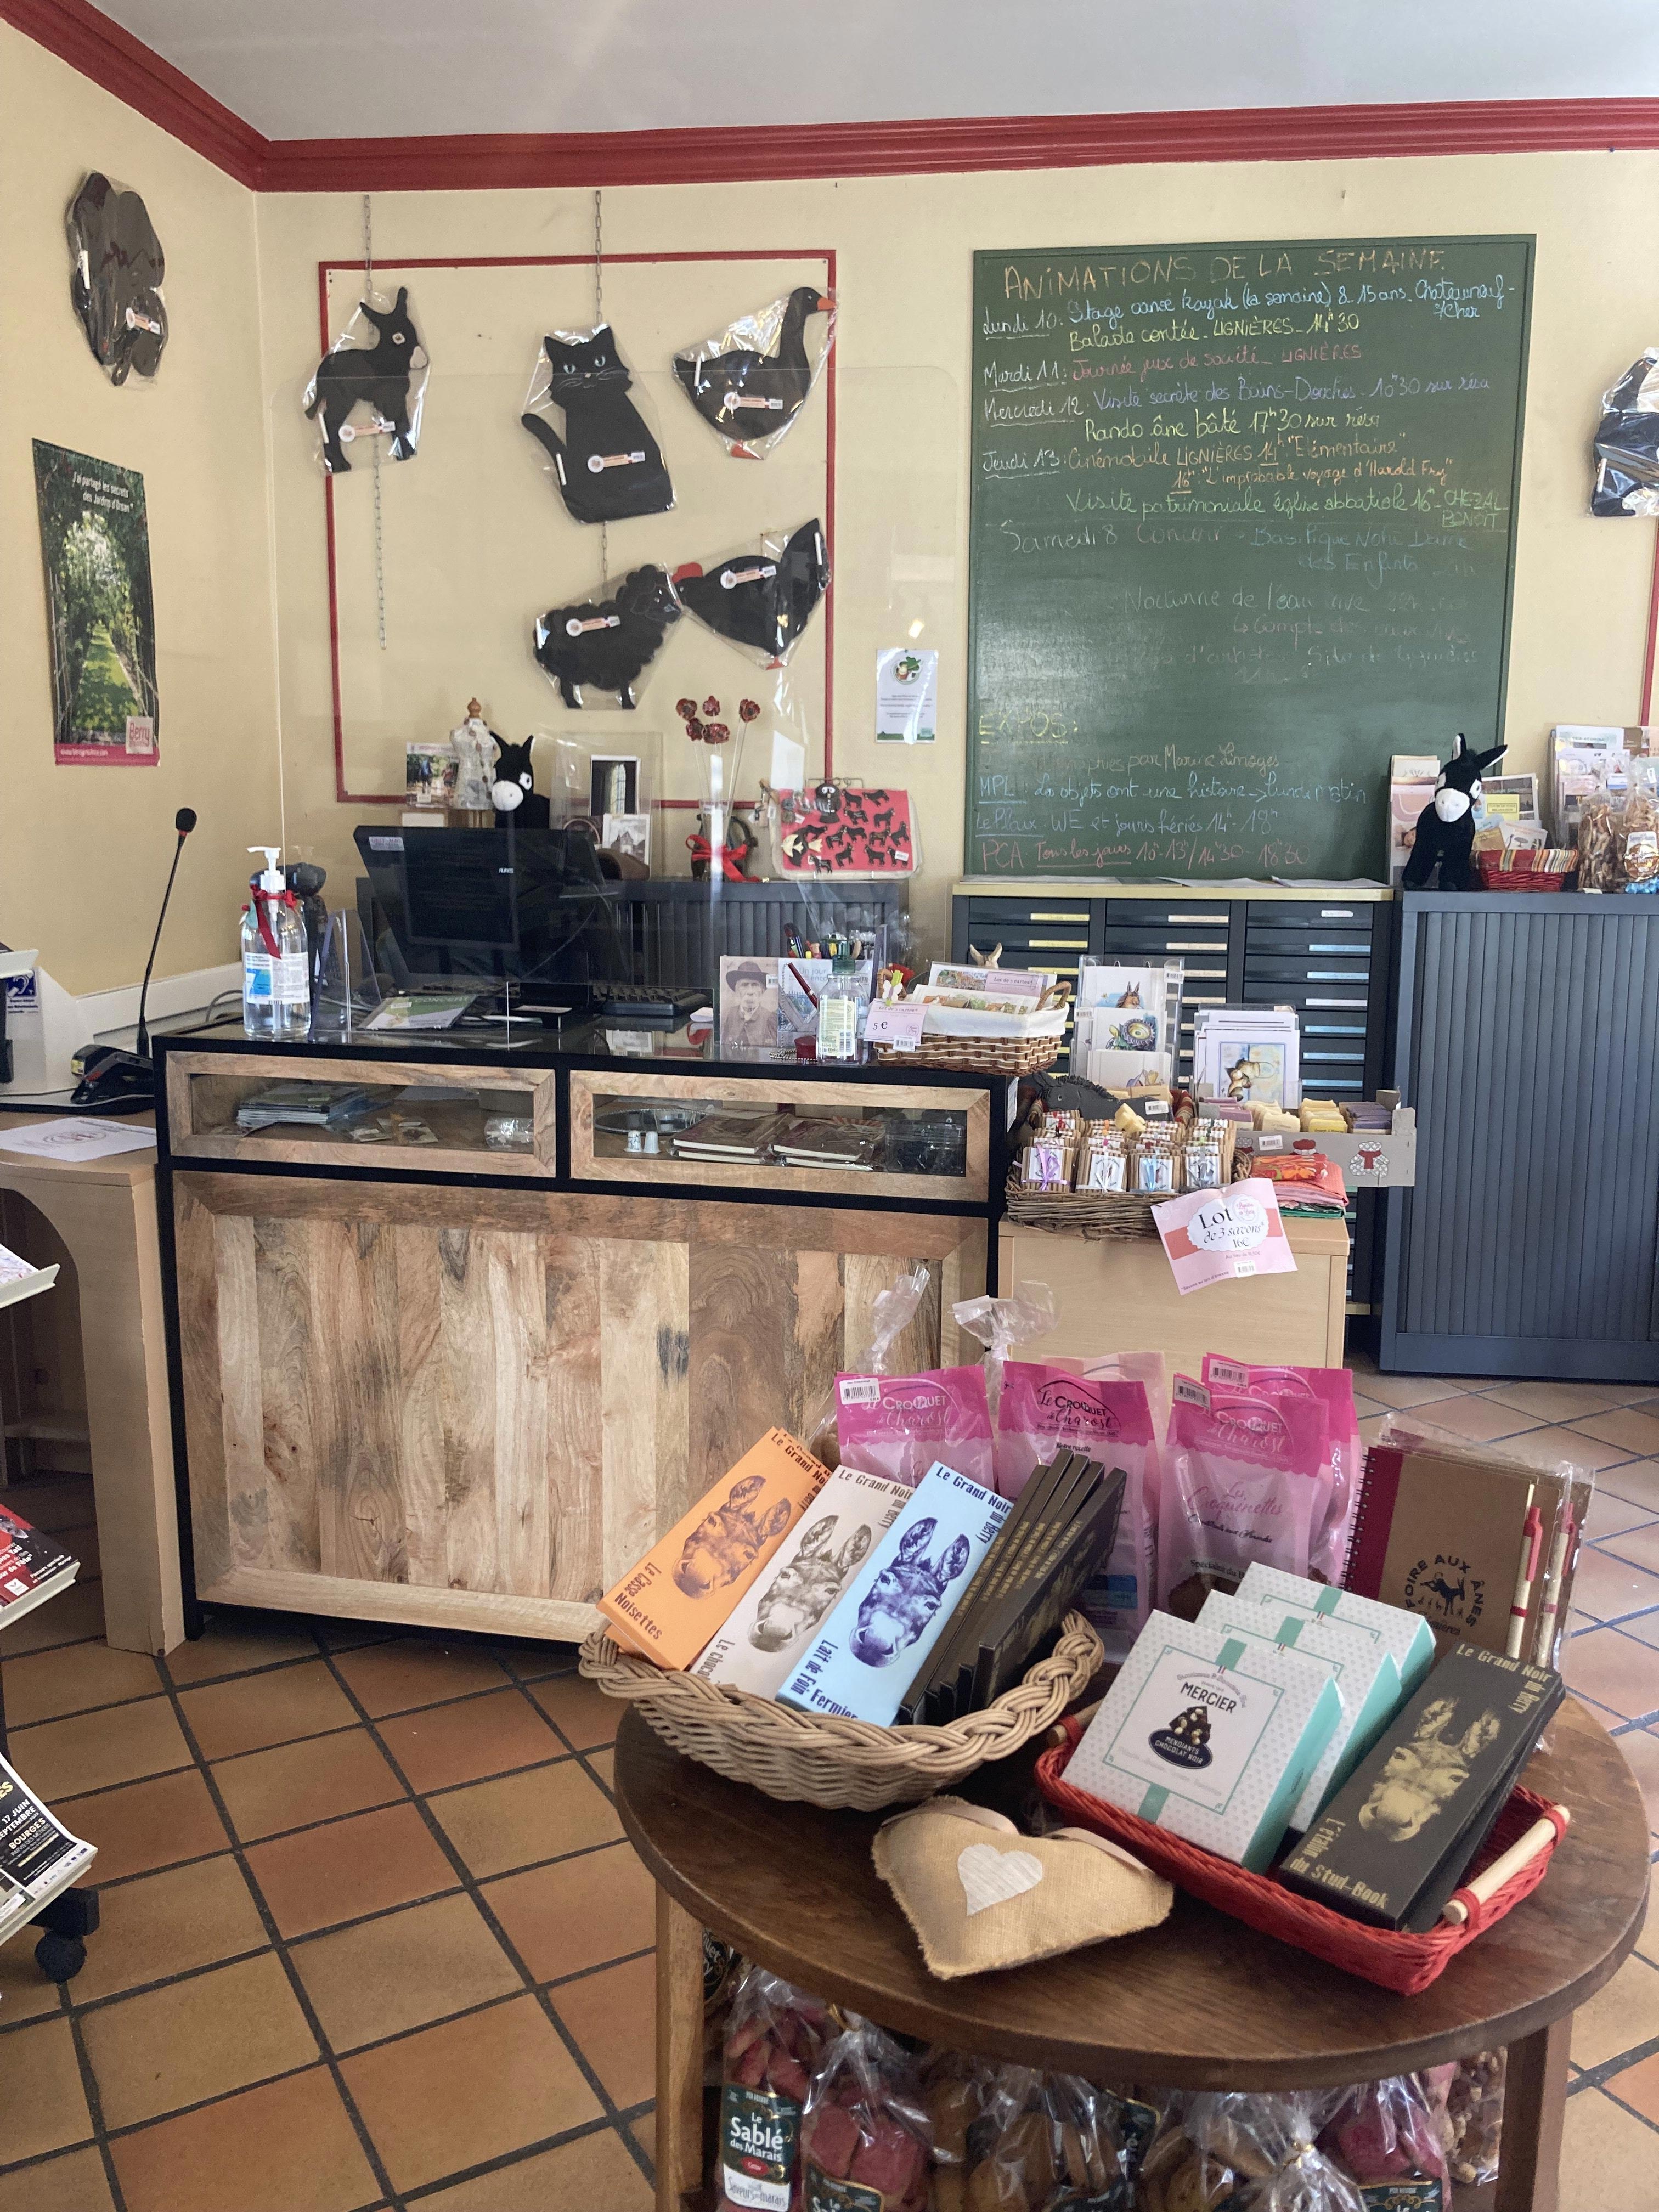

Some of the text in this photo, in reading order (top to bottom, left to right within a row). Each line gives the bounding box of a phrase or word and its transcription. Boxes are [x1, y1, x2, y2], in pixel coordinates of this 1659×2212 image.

[1004, 255, 1197, 301] ANIMATIONS
[1209, 256, 1246, 283] DE
[1259, 252, 1293, 276] LA
[983, 306, 1029, 334] Lundi
[1066, 299, 1125, 329] Stage
[1181, 288, 1238, 320] kayak
[1069, 314, 1294, 352] Balade contée LIGNIÈRES
[984, 360, 1032, 386] Mardi
[1178, 350, 1199, 368] de
[984, 394, 1053, 421] Mercredi
[1093, 384, 1143, 411] Visite
[1206, 382, 1230, 402] des
[1084, 419, 1144, 442] Rando
[983, 448, 1029, 472] Jeudi
[1176, 440, 1254, 466] LIGNIÈRES
[1066, 488, 1138, 514] Visite
[1001, 524, 1096, 554] Samedi
[1102, 523, 1119, 546] 8
[129, 722, 150, 743] Berry
[799, 967, 809, 975] Un
[873, 1021, 888, 1030] 5 €
[1198, 1207, 1234, 1229] Lot
[1204, 1227, 1225, 1244] de 3
[1054, 1396, 1107, 1417] CROQUET
[1216, 1410, 1284, 1434] CROQUET
[771, 1432, 830, 1485] Le Grand Noi
[838, 1469, 853, 1481] Le
[855, 1474, 889, 1493] Grand
[936, 1466, 1013, 1515] Le Grand Noir
[1404, 1559, 1429, 1609] FOIRE
[1434, 1553, 1471, 1575] AUX
[613, 1592, 663, 1641] Noisettes
[790, 1638, 839, 1696] Lait de Foin
[1455, 1644, 1553, 1683] Le Grand Noir
[1180, 1681, 1237, 1713] MERCIER
[1154, 1739, 1203, 1764] CHOCOLAT NOIR
[1164, 1736, 1199, 1755] MENDIANTS
[0, 1805, 36, 1841] EPTEMBRE
[1, 1798, 31, 1824] 17 JUIN
[8, 1817, 46, 1850] BOURGES
[1289, 1857, 1390, 1910] du Stud-Book
[730, 2115, 784, 2151] Sablé
[751, 2112, 762, 2124] Le
[730, 2138, 782, 2162] des Marais
